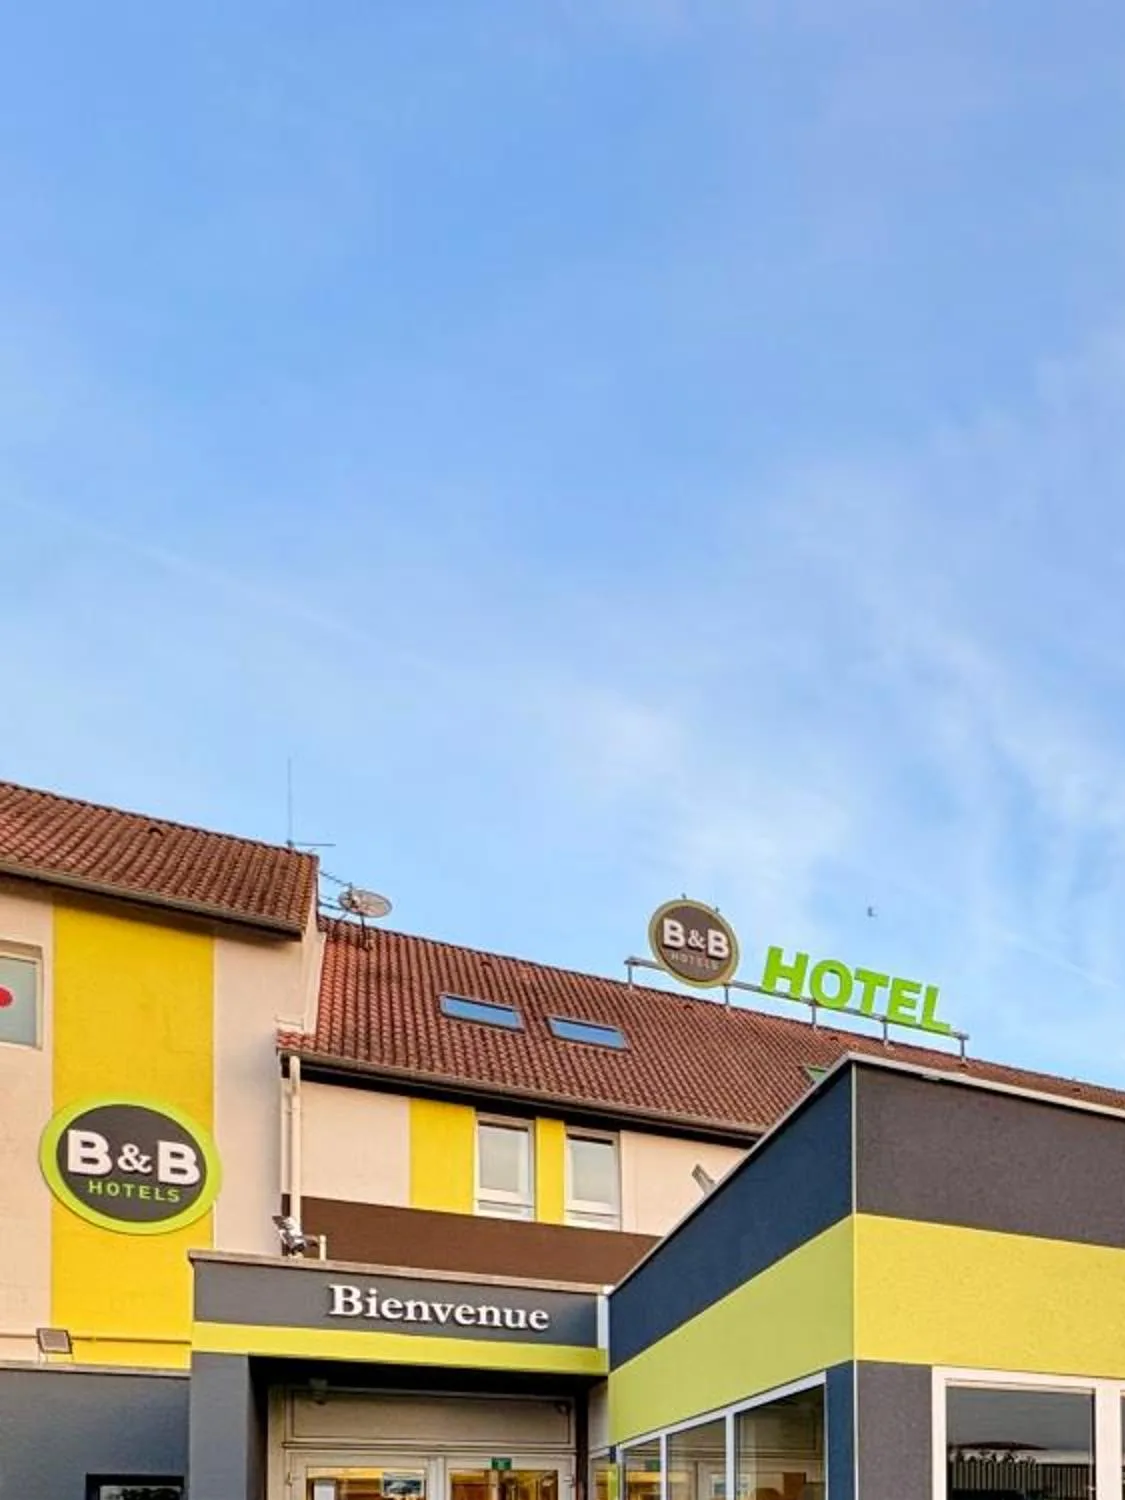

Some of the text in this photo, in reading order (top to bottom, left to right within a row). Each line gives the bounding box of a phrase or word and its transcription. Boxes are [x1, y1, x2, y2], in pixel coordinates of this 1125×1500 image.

[663, 917, 729, 958] B&B
[760, 945, 950, 1034] HOTEL
[67, 1129, 200, 1186] B&B
[88, 1180, 181, 1203] HOTELS
[329, 1284, 549, 1330] Bienvenue
